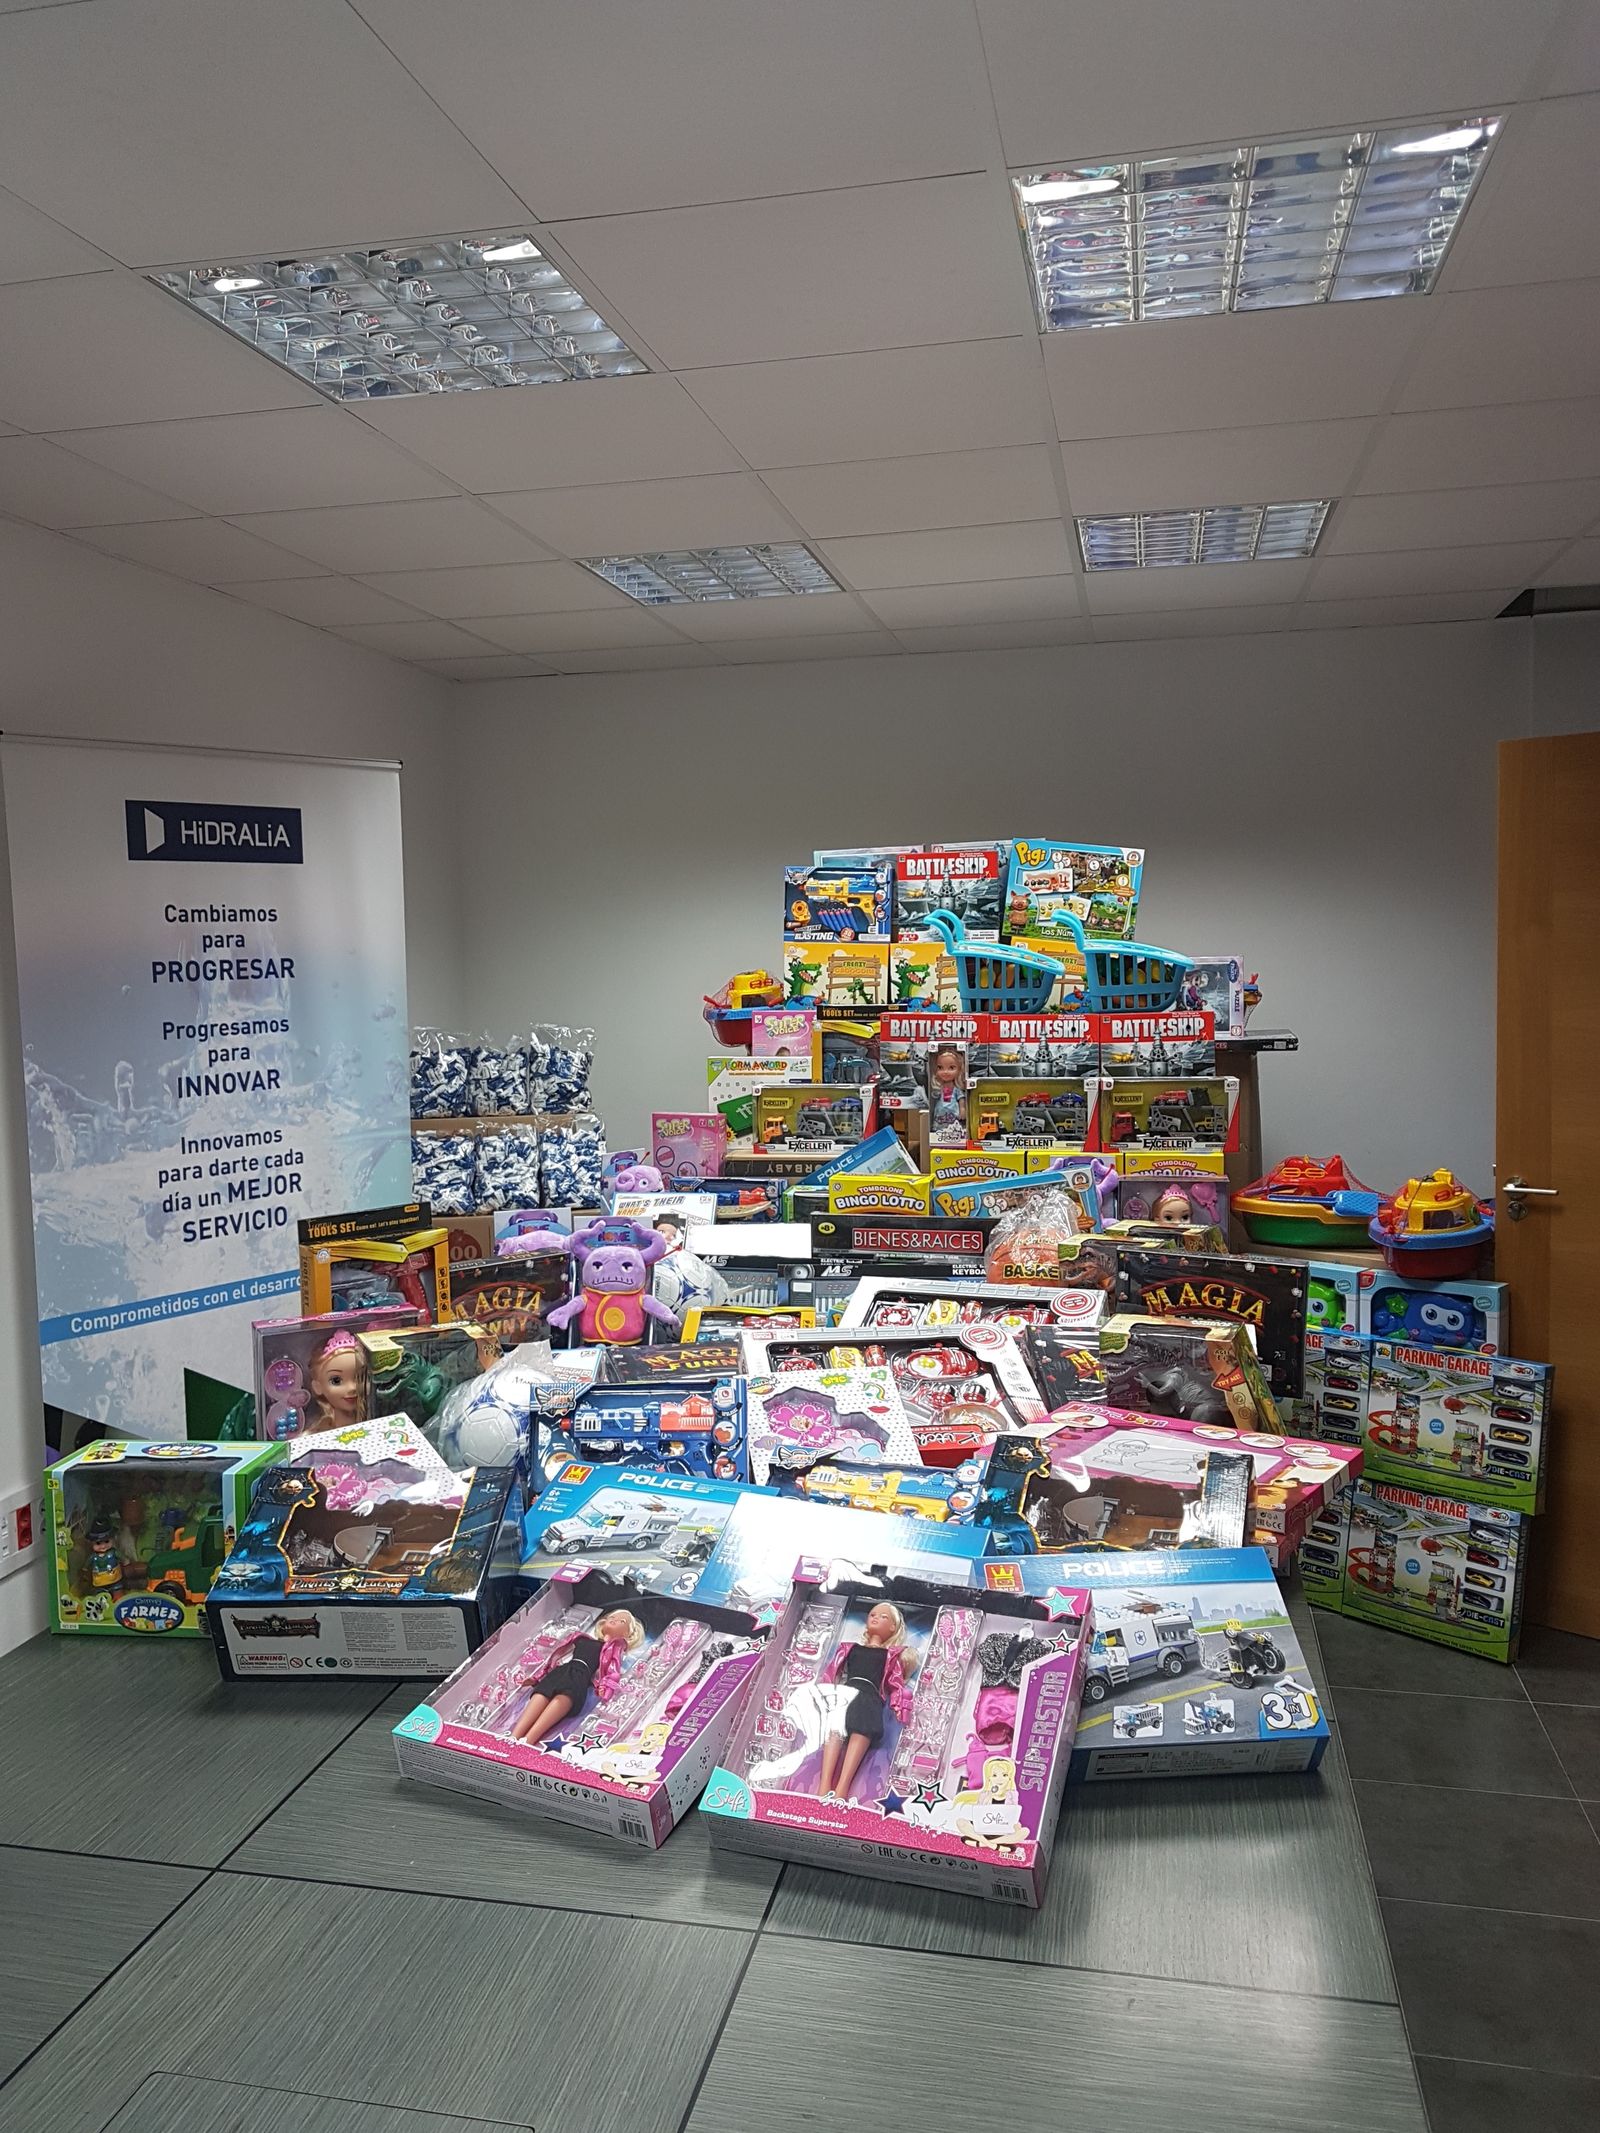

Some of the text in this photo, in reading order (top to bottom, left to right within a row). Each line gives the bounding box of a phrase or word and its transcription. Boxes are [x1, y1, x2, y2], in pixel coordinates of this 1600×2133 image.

[1014, 841, 1046, 866] Pigi
[906, 856, 988, 876] BATTLESHIP
[164, 904, 278, 924] Cambiamos
[202, 932, 246, 953] para
[1041, 927, 1092, 939] Los Núms
[152, 957, 295, 983] PROGRESAR
[822, 1008, 842, 1017] TOOLS
[843, 1008, 855, 1017] SET
[162, 1017, 290, 1042] Progresamos
[773, 1025, 801, 1036] VOICE
[890, 1018, 978, 1039] BATTLESHIP
[1000, 1018, 1090, 1039] BATTLESHIP
[1111, 1017, 1206, 1039] BATTLESHIP
[208, 1045, 251, 1067] para
[177, 1069, 281, 1099] INNOVAR
[180, 1129, 283, 1155] Innovamos
[788, 1140, 833, 1152] EXCELLENT
[1006, 1136, 1054, 1149] EXCELLENT
[1143, 1137, 1193, 1150] EXCELLENT
[158, 1149, 304, 1188] para darte cada
[817, 1155, 855, 1183] POLICE
[957, 1157, 999, 1166] TOMBOLONE
[1153, 1160, 1198, 1168] TOMBOLONE
[936, 1166, 1018, 1179] BINGO LOTTO
[162, 1172, 303, 1214] día un MEJOR
[857, 1184, 904, 1195] TOMBOLONE
[616, 1207, 646, 1217] NAME?
[618, 1195, 686, 1209] WHAT'S THEIR
[835, 1194, 925, 1210] BINGO LOTTO
[936, 1191, 975, 1217] Pigi
[182, 1206, 288, 1244] SERVICIO
[308, 1225, 338, 1238] TOOLS
[340, 1221, 357, 1234] SET
[598, 1230, 631, 1242] HOME
[1004, 1263, 1059, 1280] BASKE
[70, 1273, 301, 1334] Comprometidos con el desarro
[450, 1286, 541, 1321] MAGIA
[1142, 1283, 1264, 1326] MAGIA
[1305, 1333, 1324, 1349] AGE
[643, 1347, 738, 1368] MAGI
[668, 1358, 738, 1371] FUNN
[1395, 1347, 1444, 1368] PARKING
[1447, 1355, 1493, 1377] GARAGE
[1217, 1377, 1229, 1387] TRY
[1325, 1431, 1361, 1443] DIE-CAST
[617, 1472, 698, 1491] POLICE
[1491, 1466, 1531, 1480] DIE-CAST
[48, 1480, 58, 1488] 3+
[1375, 1484, 1423, 1508] PARKING
[1425, 1496, 1470, 1520] GARAGE
[1061, 1558, 1168, 1580] POLICE
[1304, 1564, 1339, 1578] DIE-CAST
[120, 1606, 179, 1620] FARMER
[1465, 1609, 1505, 1627] DIE-CAST
[668, 1663, 749, 1748] SUPERSTAR
[1019, 1670, 1067, 1793] SUPERSTAR
[766, 1809, 849, 1829] Backstage Superstar
